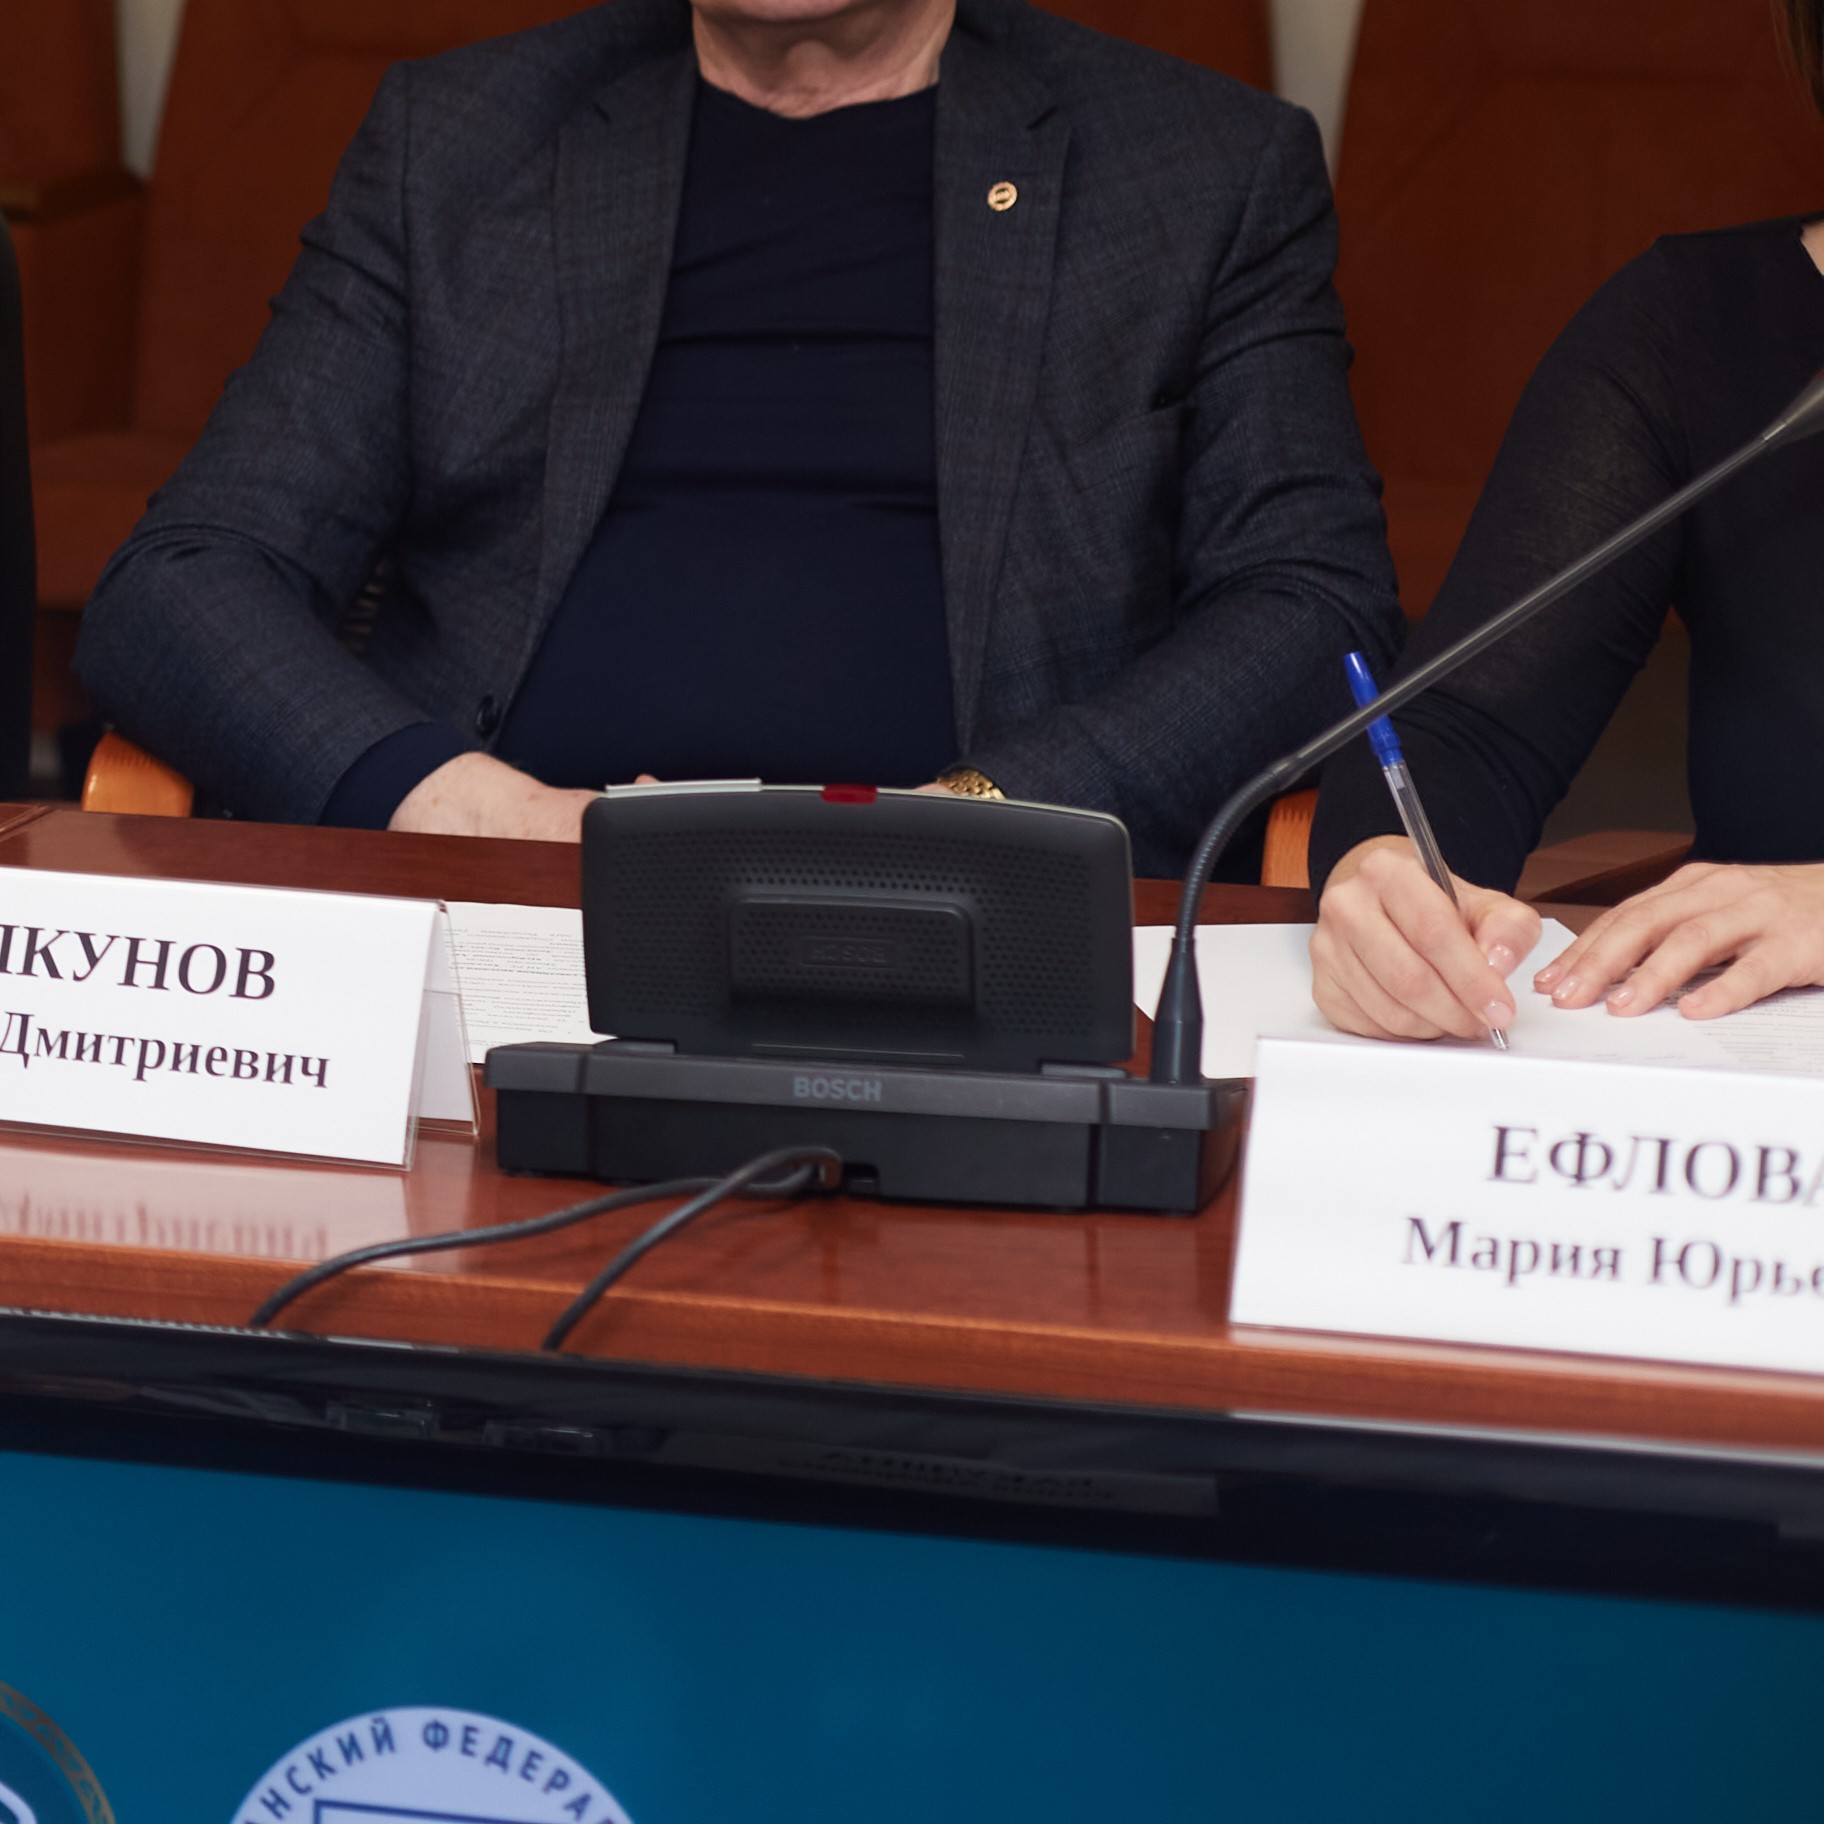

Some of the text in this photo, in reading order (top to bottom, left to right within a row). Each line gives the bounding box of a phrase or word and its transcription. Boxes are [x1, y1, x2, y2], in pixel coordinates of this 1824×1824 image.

[792, 1075, 883, 1104] BOSCH
[1403, 1216, 1622, 1288] Мария
[243, 1716, 397, 1824] НСКИЙ
